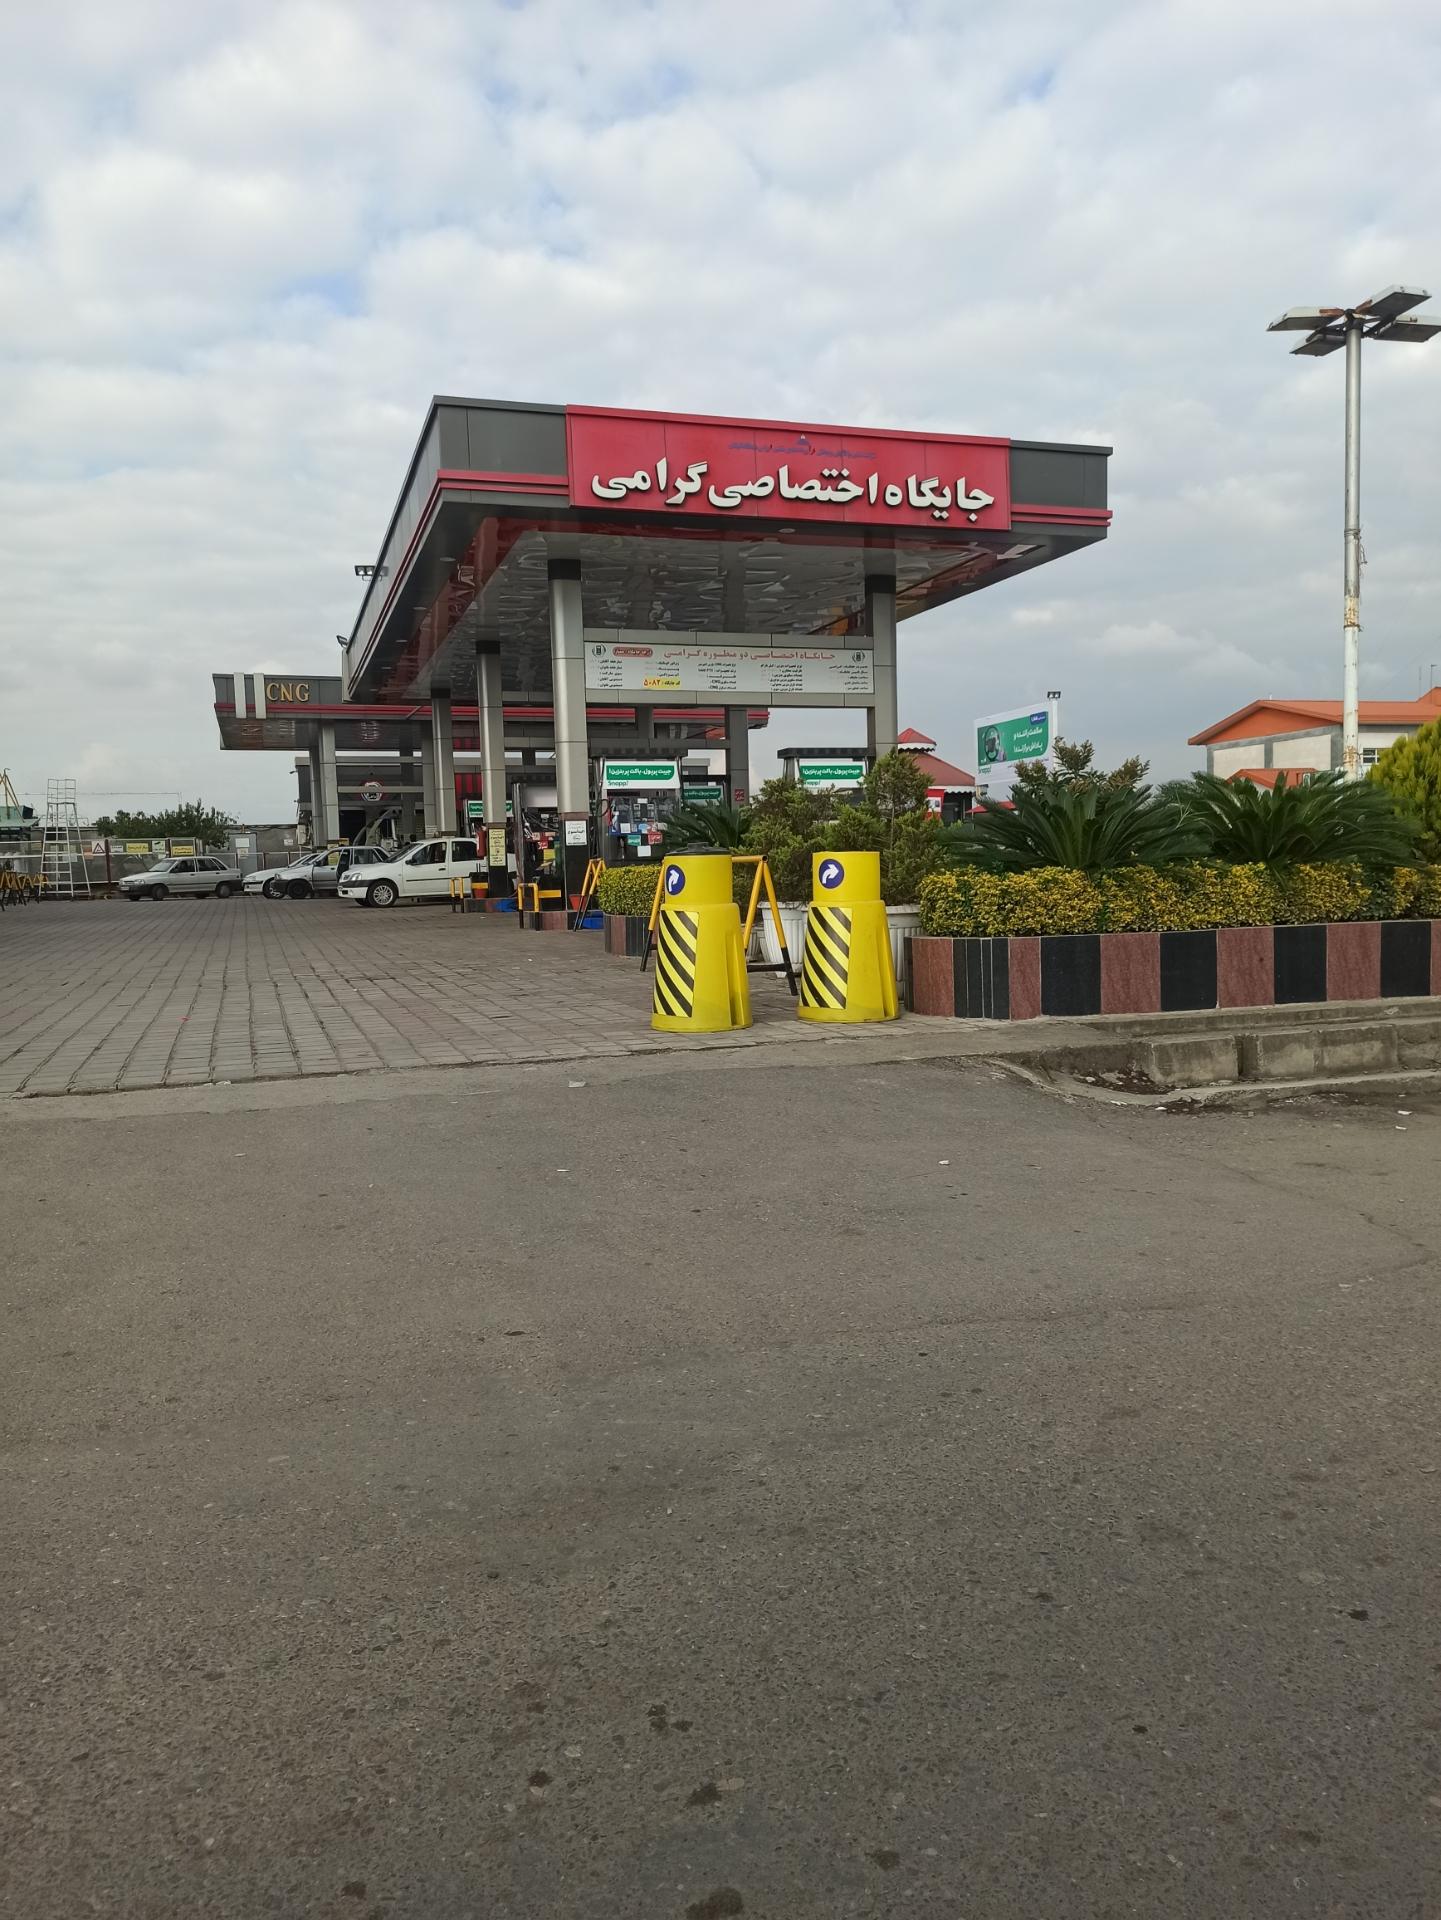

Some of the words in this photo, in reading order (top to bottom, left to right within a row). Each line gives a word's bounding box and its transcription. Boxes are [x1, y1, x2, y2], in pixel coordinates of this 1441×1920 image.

[590, 456, 708, 504] گرامی
[708, 464, 879, 508] اختصاصی
[885, 474, 996, 523] جایگاه
[266, 682, 310, 702] CNG
